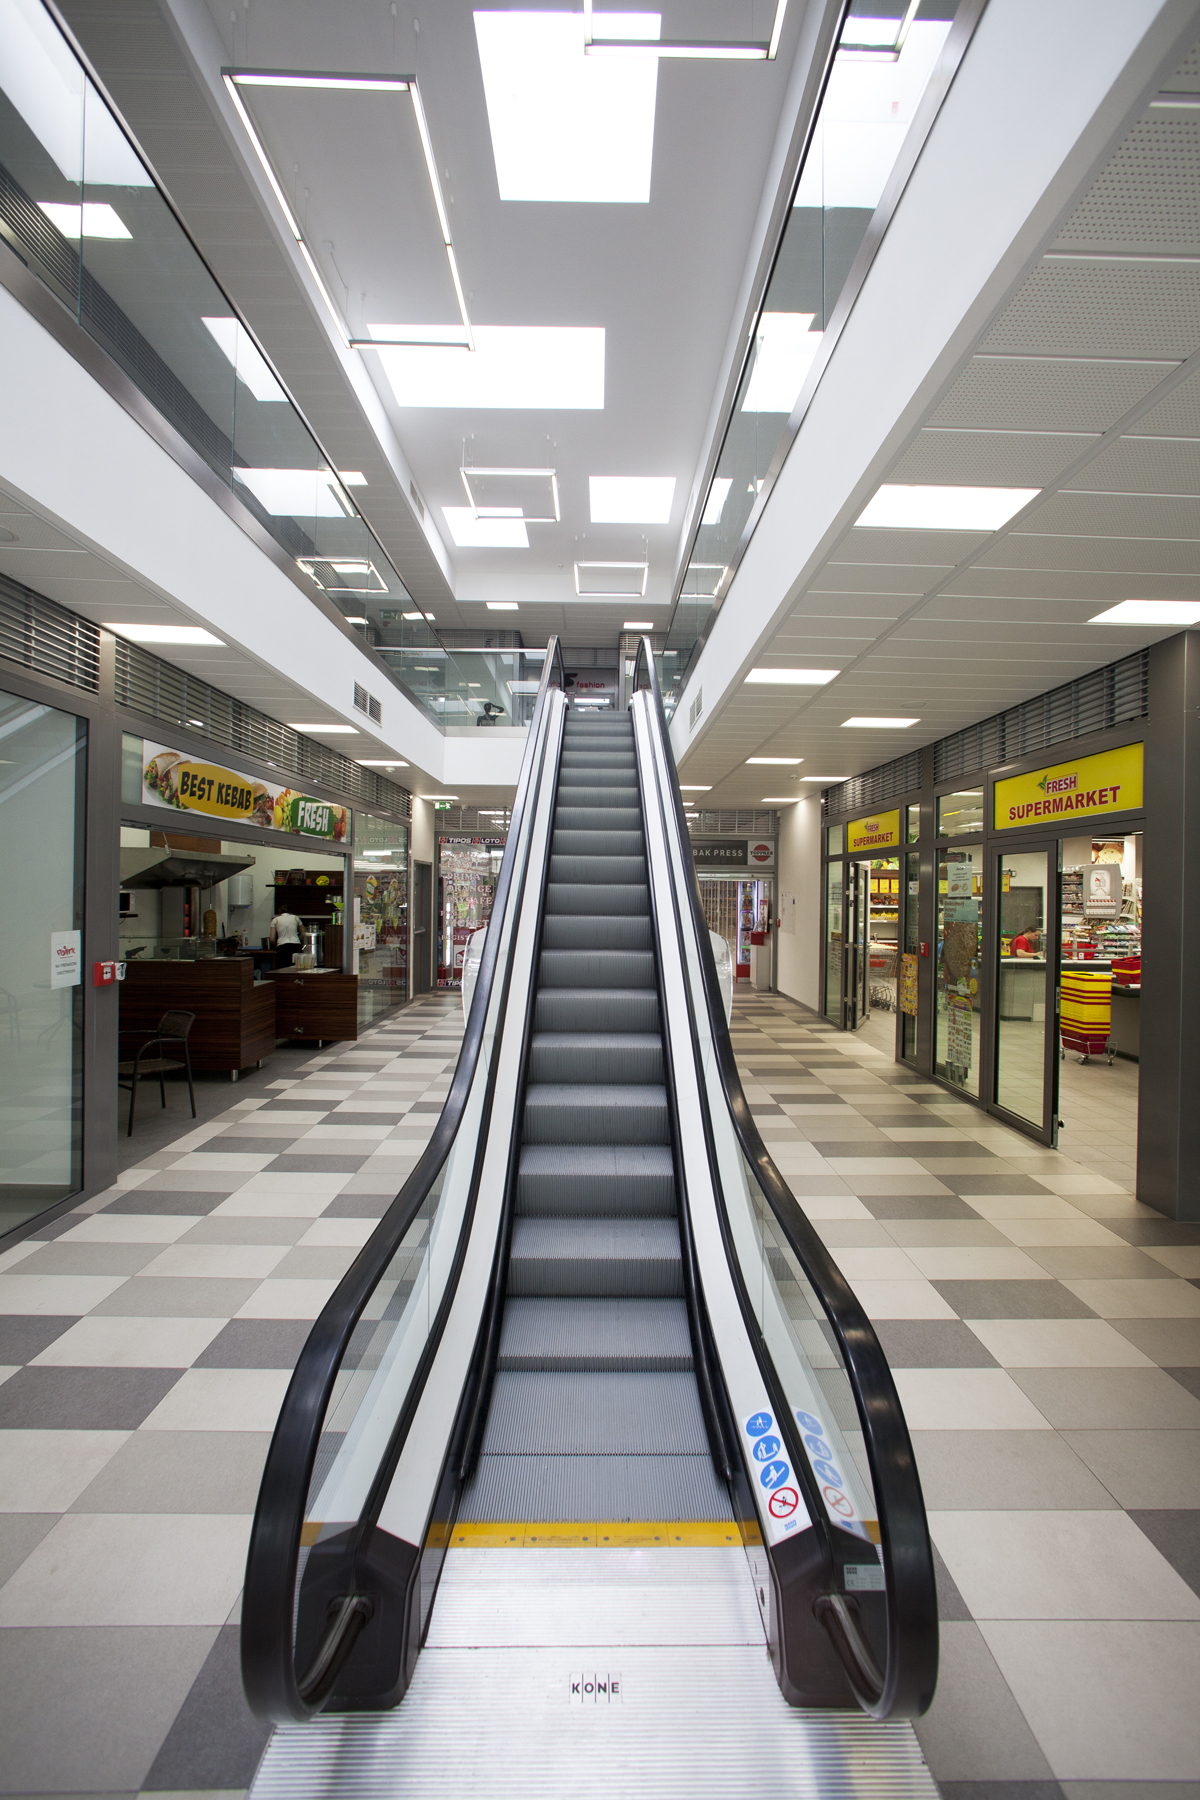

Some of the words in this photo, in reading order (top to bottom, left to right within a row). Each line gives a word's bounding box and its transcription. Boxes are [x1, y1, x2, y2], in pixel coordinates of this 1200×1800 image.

[576, 681, 605, 689] fashion
[180, 771, 214, 801] BEST
[217, 782, 252, 810] KEBAB
[1046, 775, 1077, 794] FRESH
[1009, 785, 1121, 820] SUPERMARKET
[297, 801, 330, 832] FRESH
[867, 823, 879, 832] FRESH
[853, 832, 893, 847] SUPERMARKET
[714, 849, 743, 857] PRESS
[572, 1682, 619, 1693] KONE
